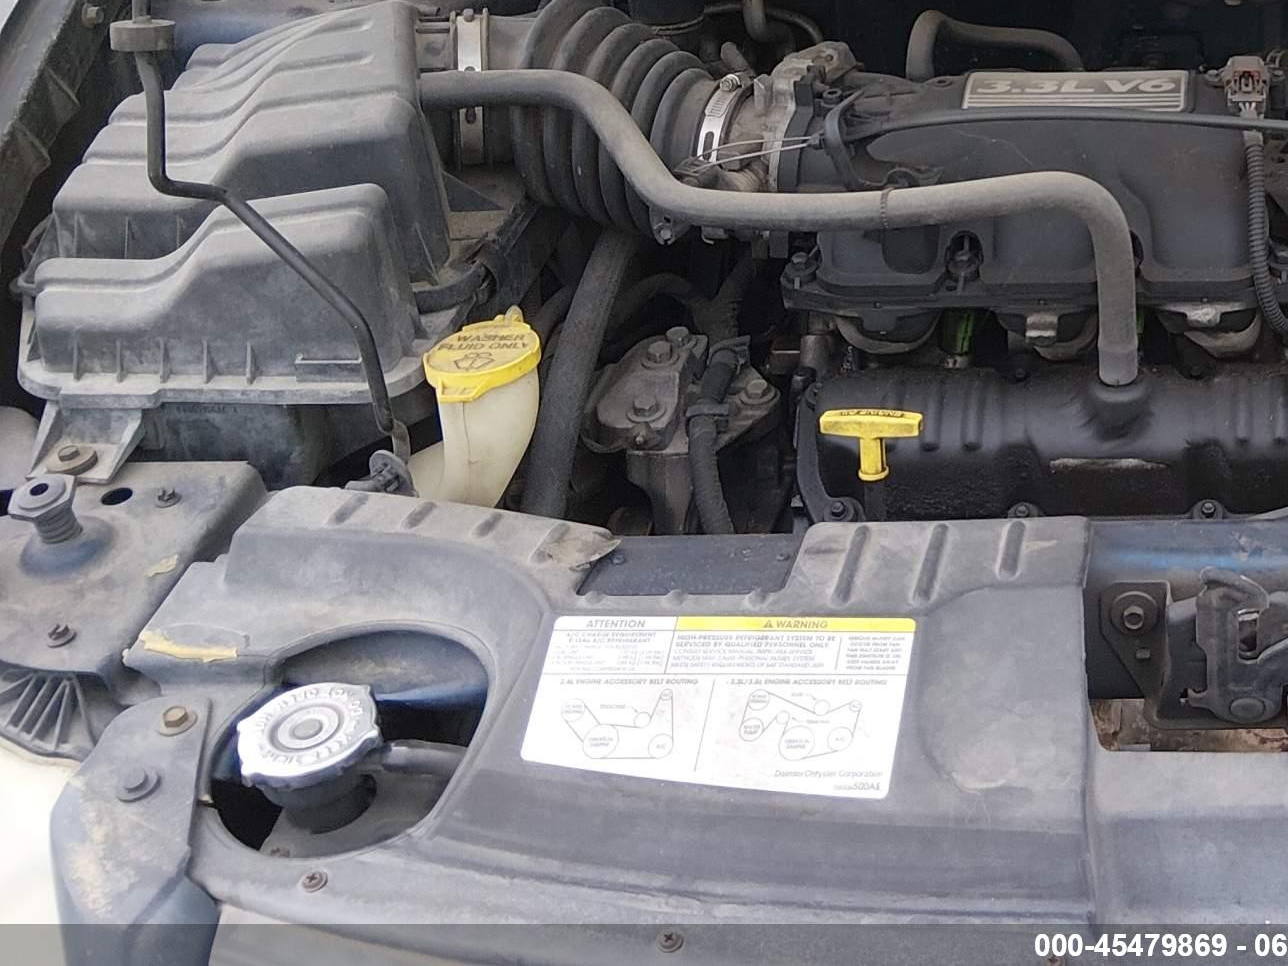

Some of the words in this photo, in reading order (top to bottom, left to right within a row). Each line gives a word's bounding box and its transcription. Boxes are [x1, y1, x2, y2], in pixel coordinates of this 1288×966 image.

[975, 79, 1095, 94] 3.3L
[1104, 79, 1178, 93] V6
[457, 334, 526, 342] WASHER
[437, 343, 485, 351] FLUID
[585, 619, 646, 628] ATTENTION
[776, 620, 829, 629] WARNING
